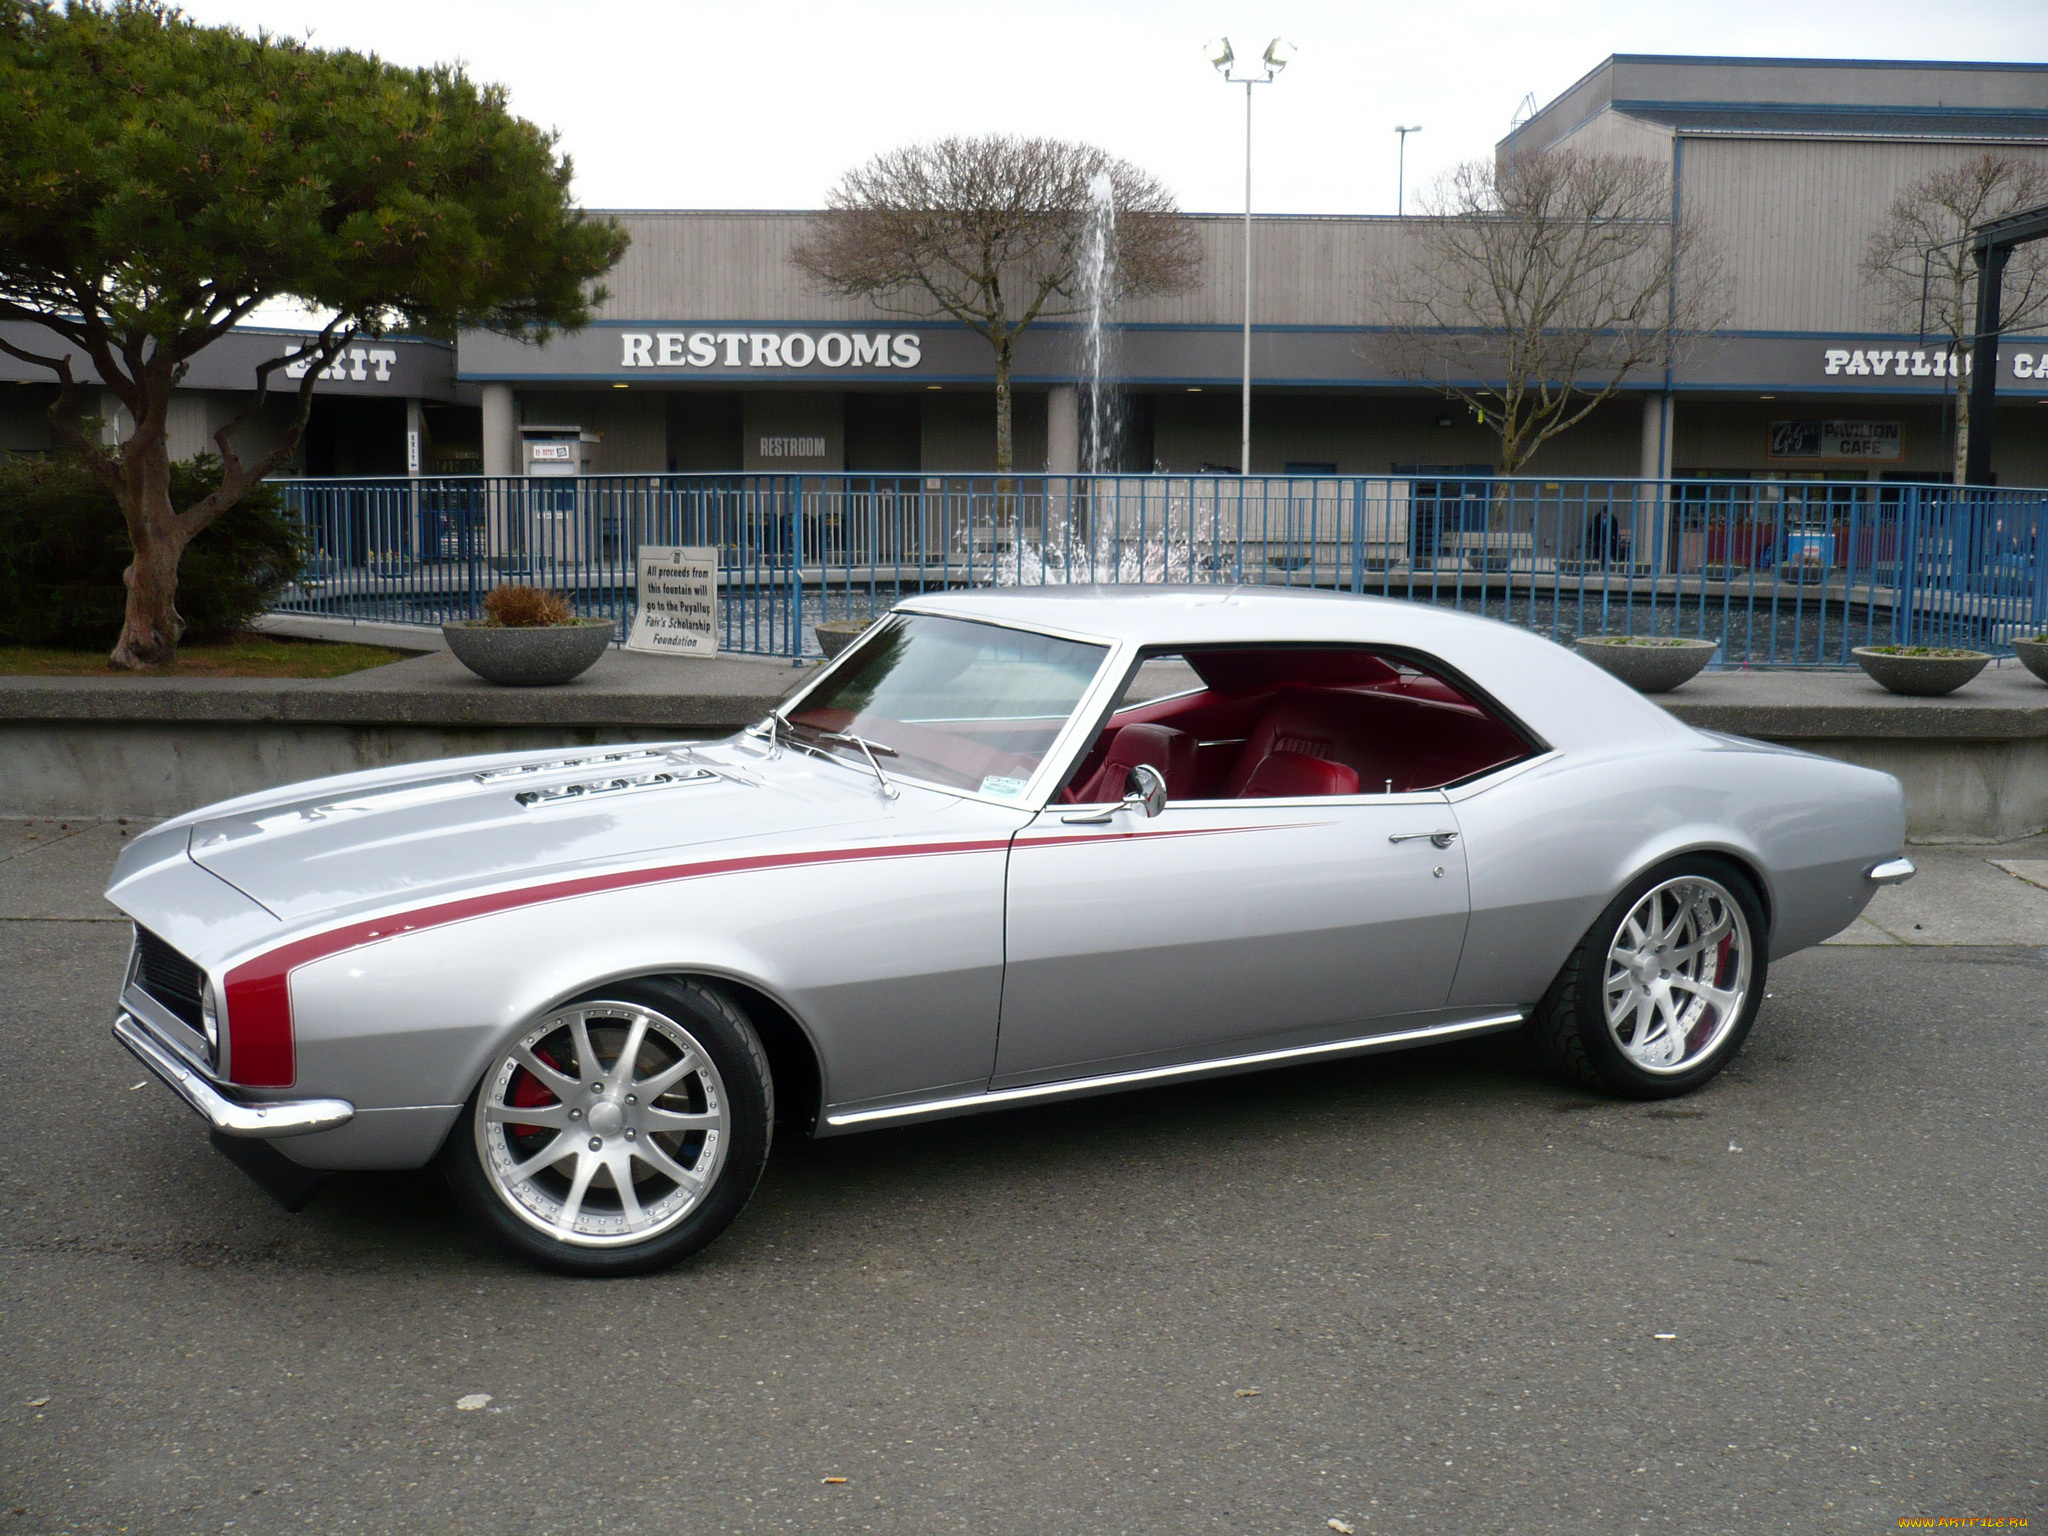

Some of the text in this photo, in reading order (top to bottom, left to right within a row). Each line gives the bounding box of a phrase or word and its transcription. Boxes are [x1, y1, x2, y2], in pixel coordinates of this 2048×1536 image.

[621, 333, 922, 368] RESTROOMS
[1824, 350, 2000, 378] PAVILIO
[1824, 422, 1898, 439] PAVILION
[760, 437, 826, 457] RESTROOM
[1840, 440, 1881, 455] CAFE
[647, 565, 709, 580] All proceeds from
[648, 582, 708, 596] this fountain will
[646, 600, 711, 617] go to the Puyallup
[645, 615, 711, 634] Fair's Scholarship
[652, 633, 698, 647] Foundation
